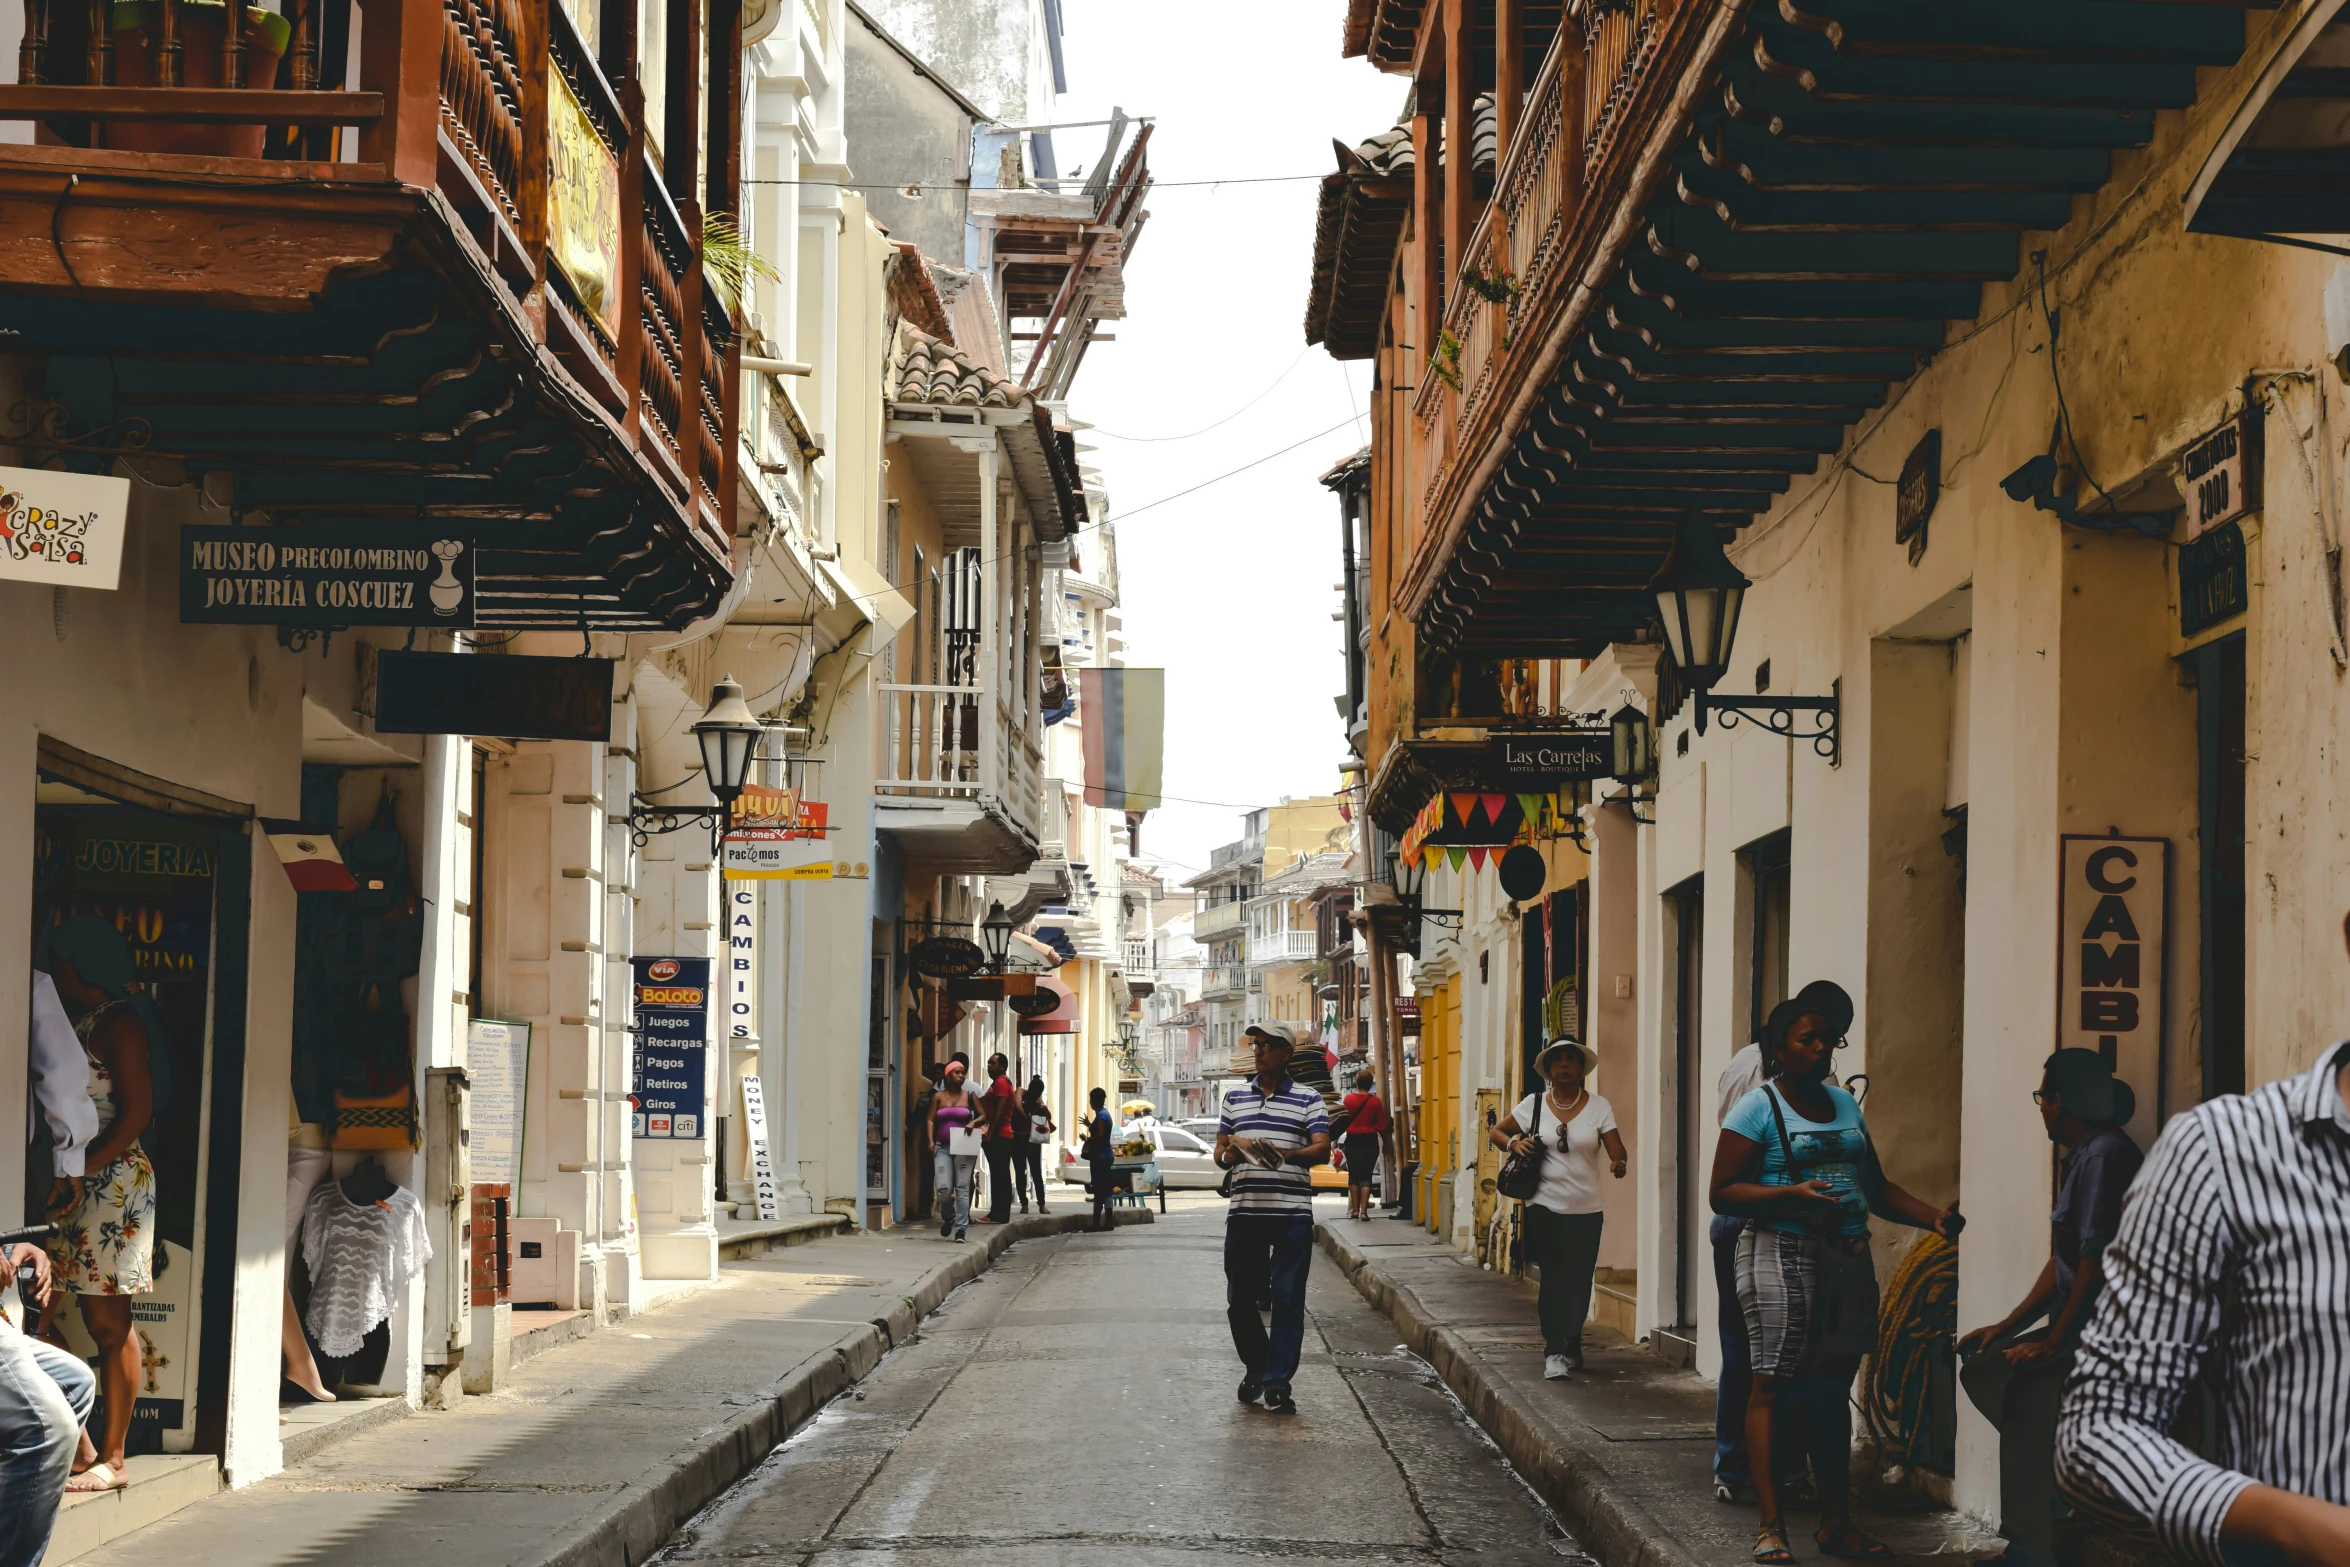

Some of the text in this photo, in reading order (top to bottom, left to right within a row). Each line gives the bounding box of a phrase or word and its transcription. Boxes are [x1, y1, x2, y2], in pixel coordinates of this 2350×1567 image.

[2199, 468, 2229, 525] 2000
[192, 540, 429, 572] MUSEO PRECOLOMBINO
[204, 574, 415, 609] JOYERÍA COSCUEZ
[1506, 743, 1533, 765] Las
[1540, 766, 1580, 774] BOUTIQUE
[75, 839, 211, 877] JOYERIA
[732, 892, 753, 1038] CAMBIOS
[940, 963, 970, 974] BUENA
[643, 988, 702, 1003] Baloto
[648, 1016, 690, 1029] Juegos
[647, 1036, 703, 1050] Recargas
[647, 1057, 684, 1070] Pagos
[646, 1078, 688, 1090] Retiros
[646, 1098, 676, 1110] Giros
[677, 1120, 695, 1131] citi
[744, 1076, 776, 1220] MONEY EXCHANGE
[131, 1301, 175, 1313] RANTIZADAS
